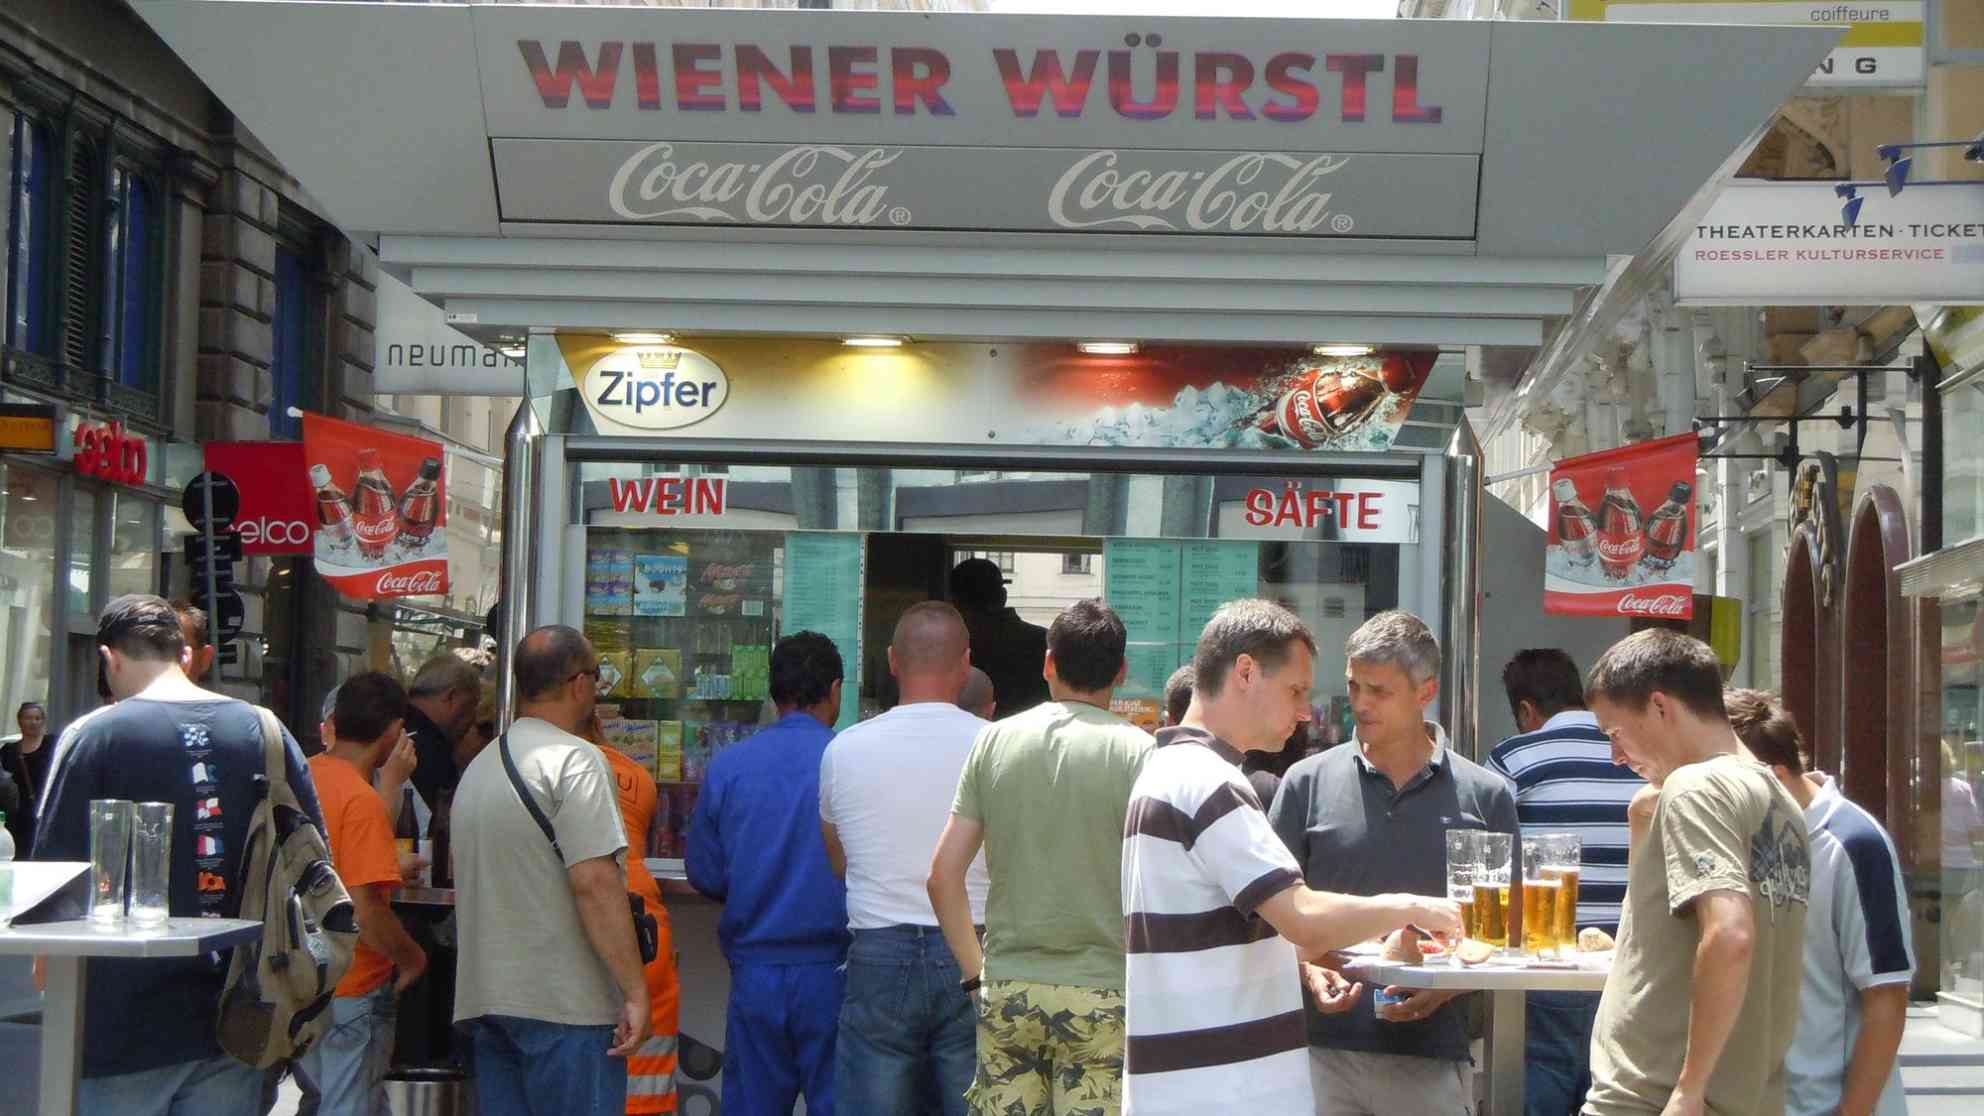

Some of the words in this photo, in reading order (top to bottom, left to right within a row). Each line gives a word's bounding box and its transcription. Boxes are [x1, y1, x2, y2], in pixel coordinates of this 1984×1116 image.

[1810, 6, 1889, 21] coiffeure
[517, 40, 956, 116] WIENER
[992, 33, 1442, 123] WÜRSTL
[608, 142, 904, 224] Coca-Cola
[1048, 150, 1350, 231] Coca-Cola
[1696, 224, 1895, 239] THEATERKARTEN
[1695, 249, 1789, 261] ROESSLER
[1796, 248, 1945, 261] KULTURSERVICE
[597, 370, 717, 415] Zipfer
[609, 476, 728, 516] WEIN
[1244, 480, 1386, 530] SÄFTE
[227, 515, 309, 544] elco
[376, 570, 443, 594] Coca-Cola
[1616, 592, 1688, 615] Coca-Cola
